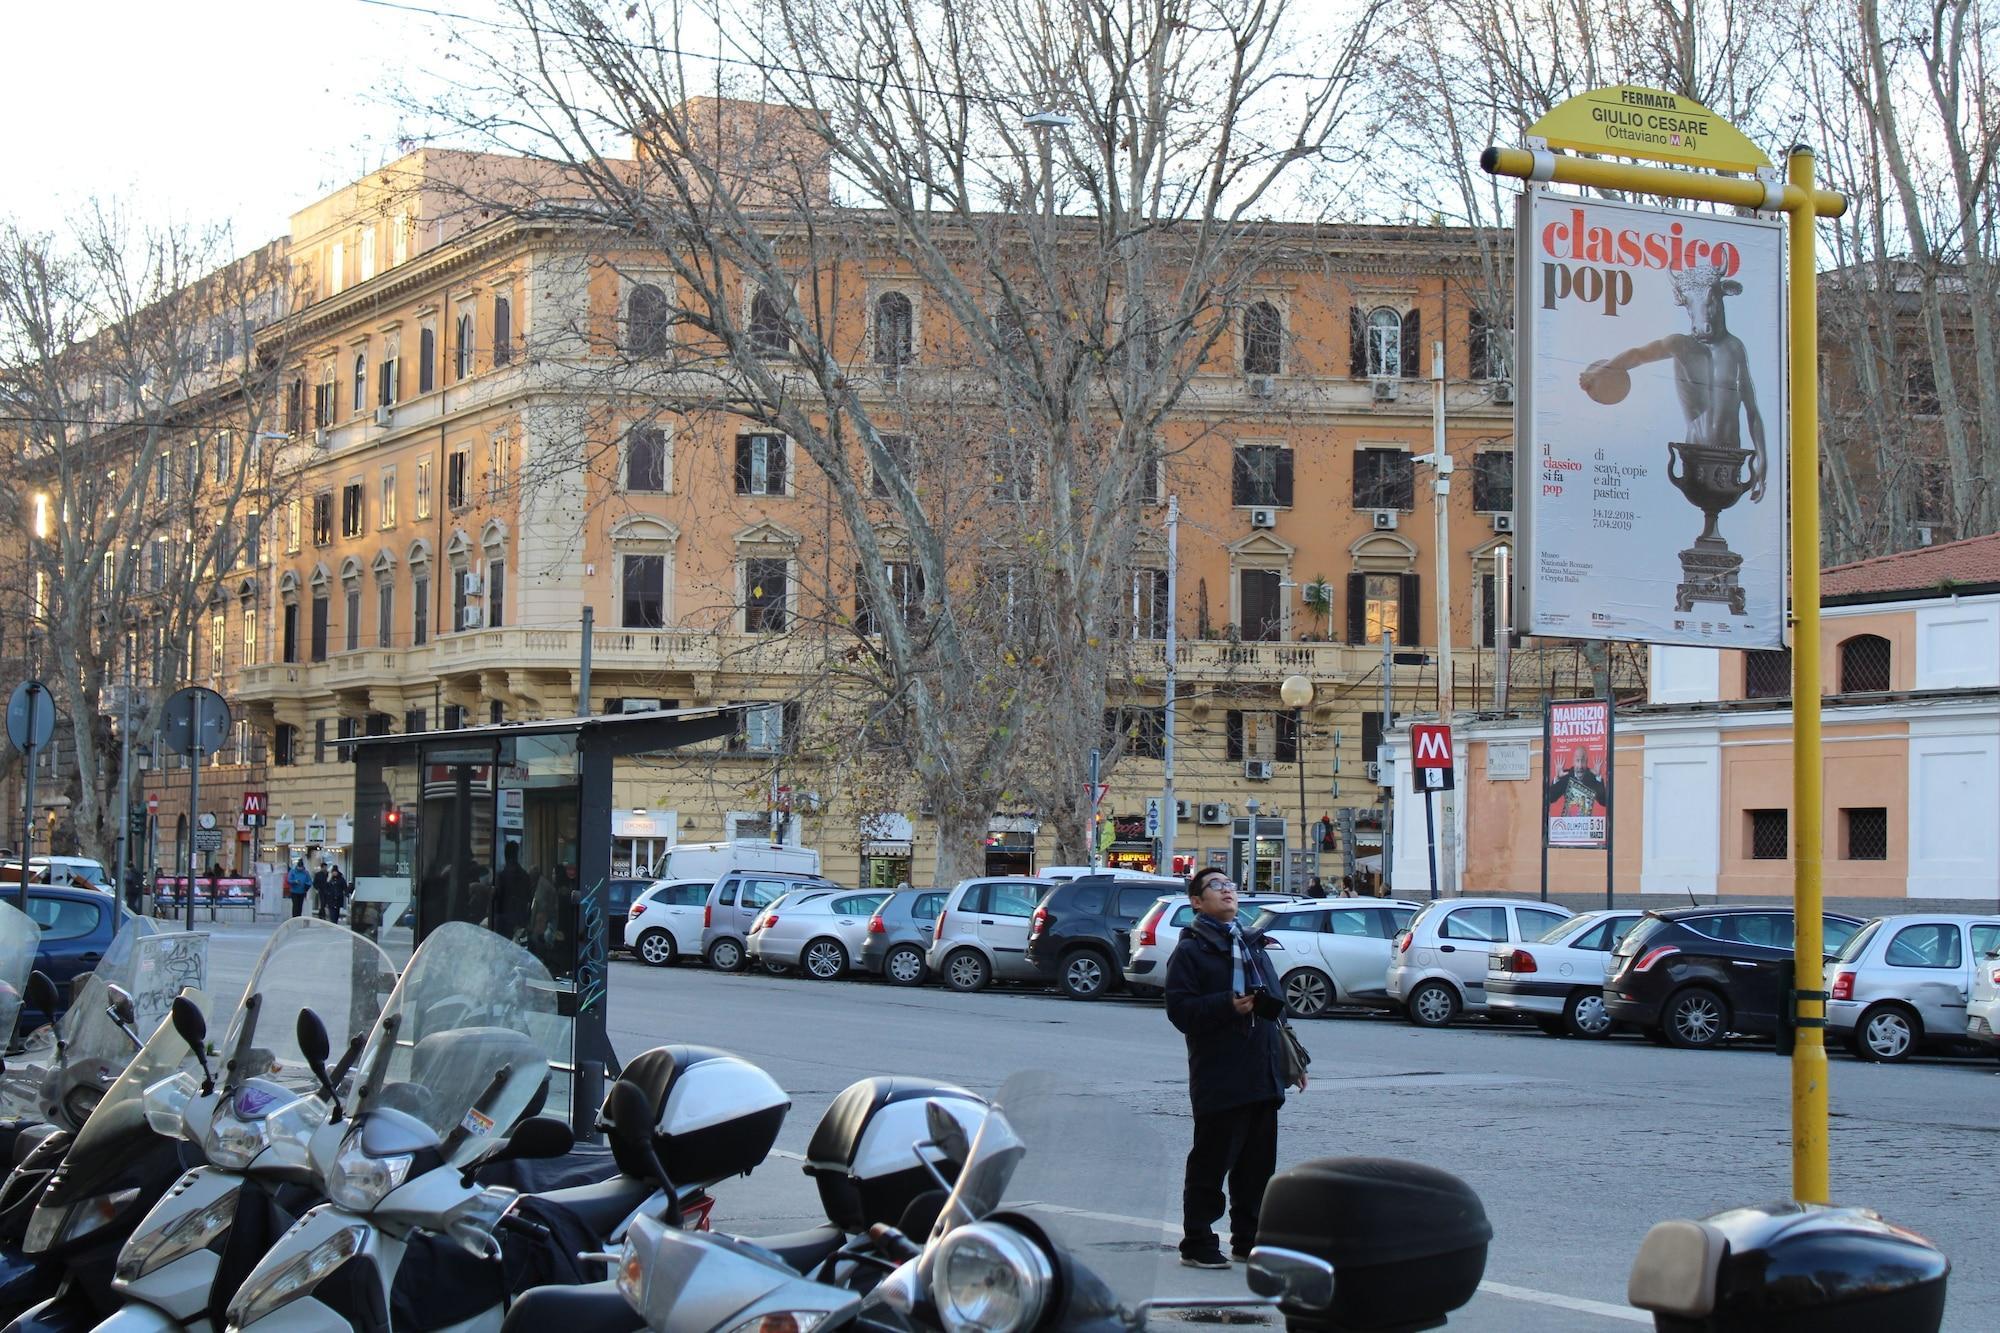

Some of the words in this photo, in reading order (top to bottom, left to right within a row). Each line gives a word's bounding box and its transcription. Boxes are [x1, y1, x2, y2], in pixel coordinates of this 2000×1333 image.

[1621, 90, 1676, 110] FERMATA
[1592, 107, 1643, 127] GIULIO
[1648, 115, 1709, 136] CESARE
[1605, 124, 1667, 145] (Ottaviano
[1684, 136, 1697, 151] A)
[1542, 208, 1740, 278] classico
[1540, 262, 1634, 317] pop
[1543, 444, 1550, 456] il
[1594, 448, 1604, 461] di
[1543, 457, 1582, 471] classico
[1594, 462, 1620, 475] scavi,
[1621, 465, 1648, 479] copie
[1542, 469, 1551, 481] si
[1553, 469, 1564, 482] fa
[1601, 474, 1621, 487] altri
[1543, 484, 1563, 497] pop
[1593, 487, 1630, 500] pasticci
[1593, 508, 1634, 521] 14.12.2018
[1593, 518, 1632, 531] 7.04.2019
[1553, 706, 1604, 721] MAURIZIO
[1553, 720, 1605, 736] BATTISTA
[1417, 732, 1450, 759] M
[245, 796, 259, 810] M
